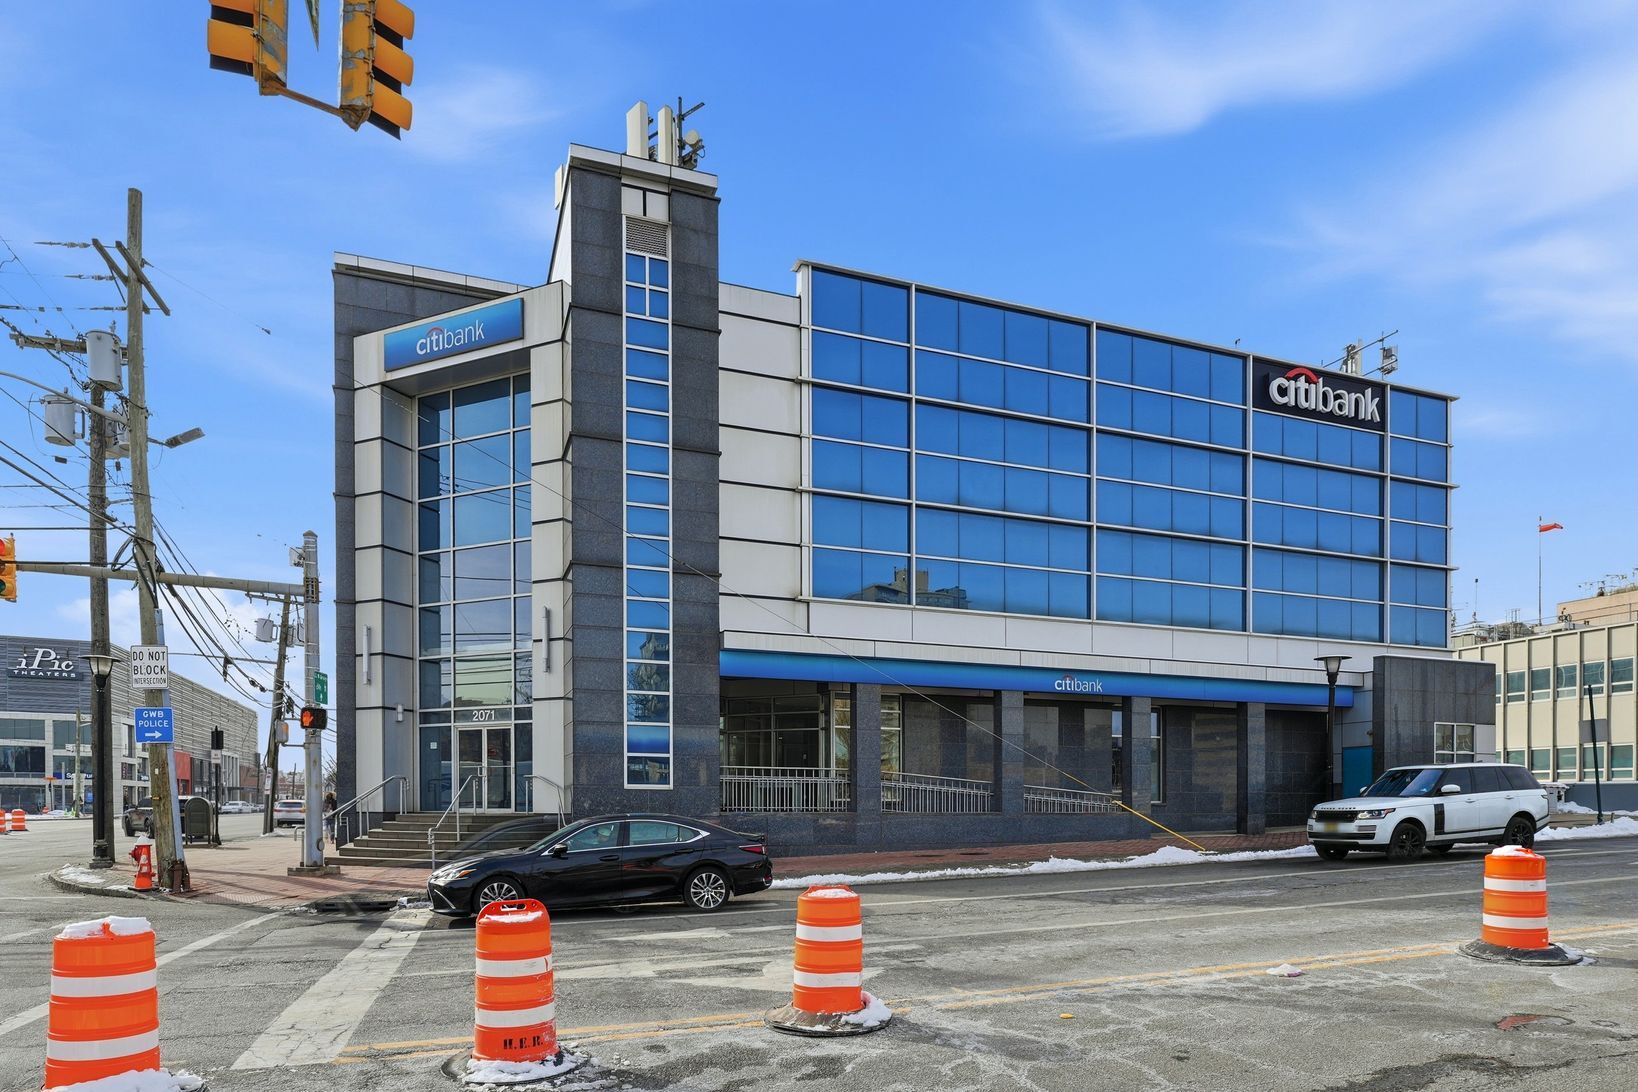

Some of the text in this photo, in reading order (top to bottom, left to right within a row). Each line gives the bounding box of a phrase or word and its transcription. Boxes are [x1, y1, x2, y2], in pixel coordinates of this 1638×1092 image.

[416, 320, 485, 355] citibank
[1269, 367, 1380, 422] citibank
[16, 648, 74, 671] iPic
[132, 651, 166, 660] DO NOT
[13, 670, 76, 678] THEATERS
[133, 665, 166, 675] BLOCK
[1054, 675, 1103, 692] citibank
[143, 710, 164, 718] GWB
[472, 710, 495, 721] 2071
[138, 720, 168, 728] POLICE
